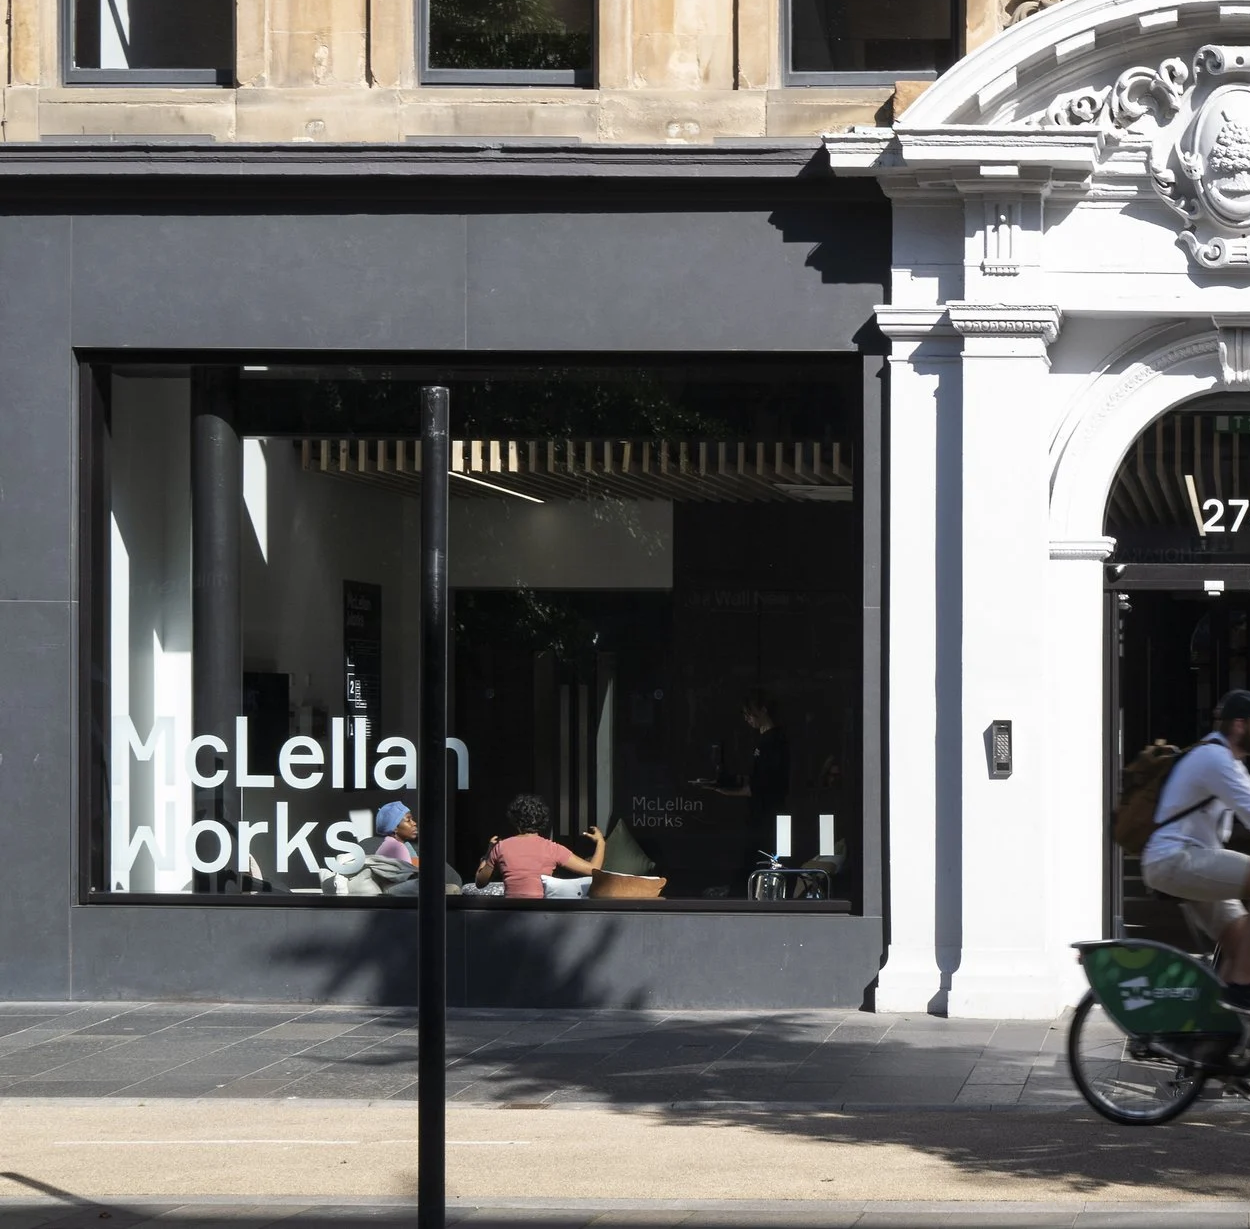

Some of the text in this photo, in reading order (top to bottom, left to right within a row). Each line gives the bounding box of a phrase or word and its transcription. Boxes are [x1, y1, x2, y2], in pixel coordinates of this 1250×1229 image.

[113, 716, 469, 790] McLellan
[633, 796, 703, 811] McLellan
[633, 813, 683, 827] Works
[113, 801, 365, 873] Works
